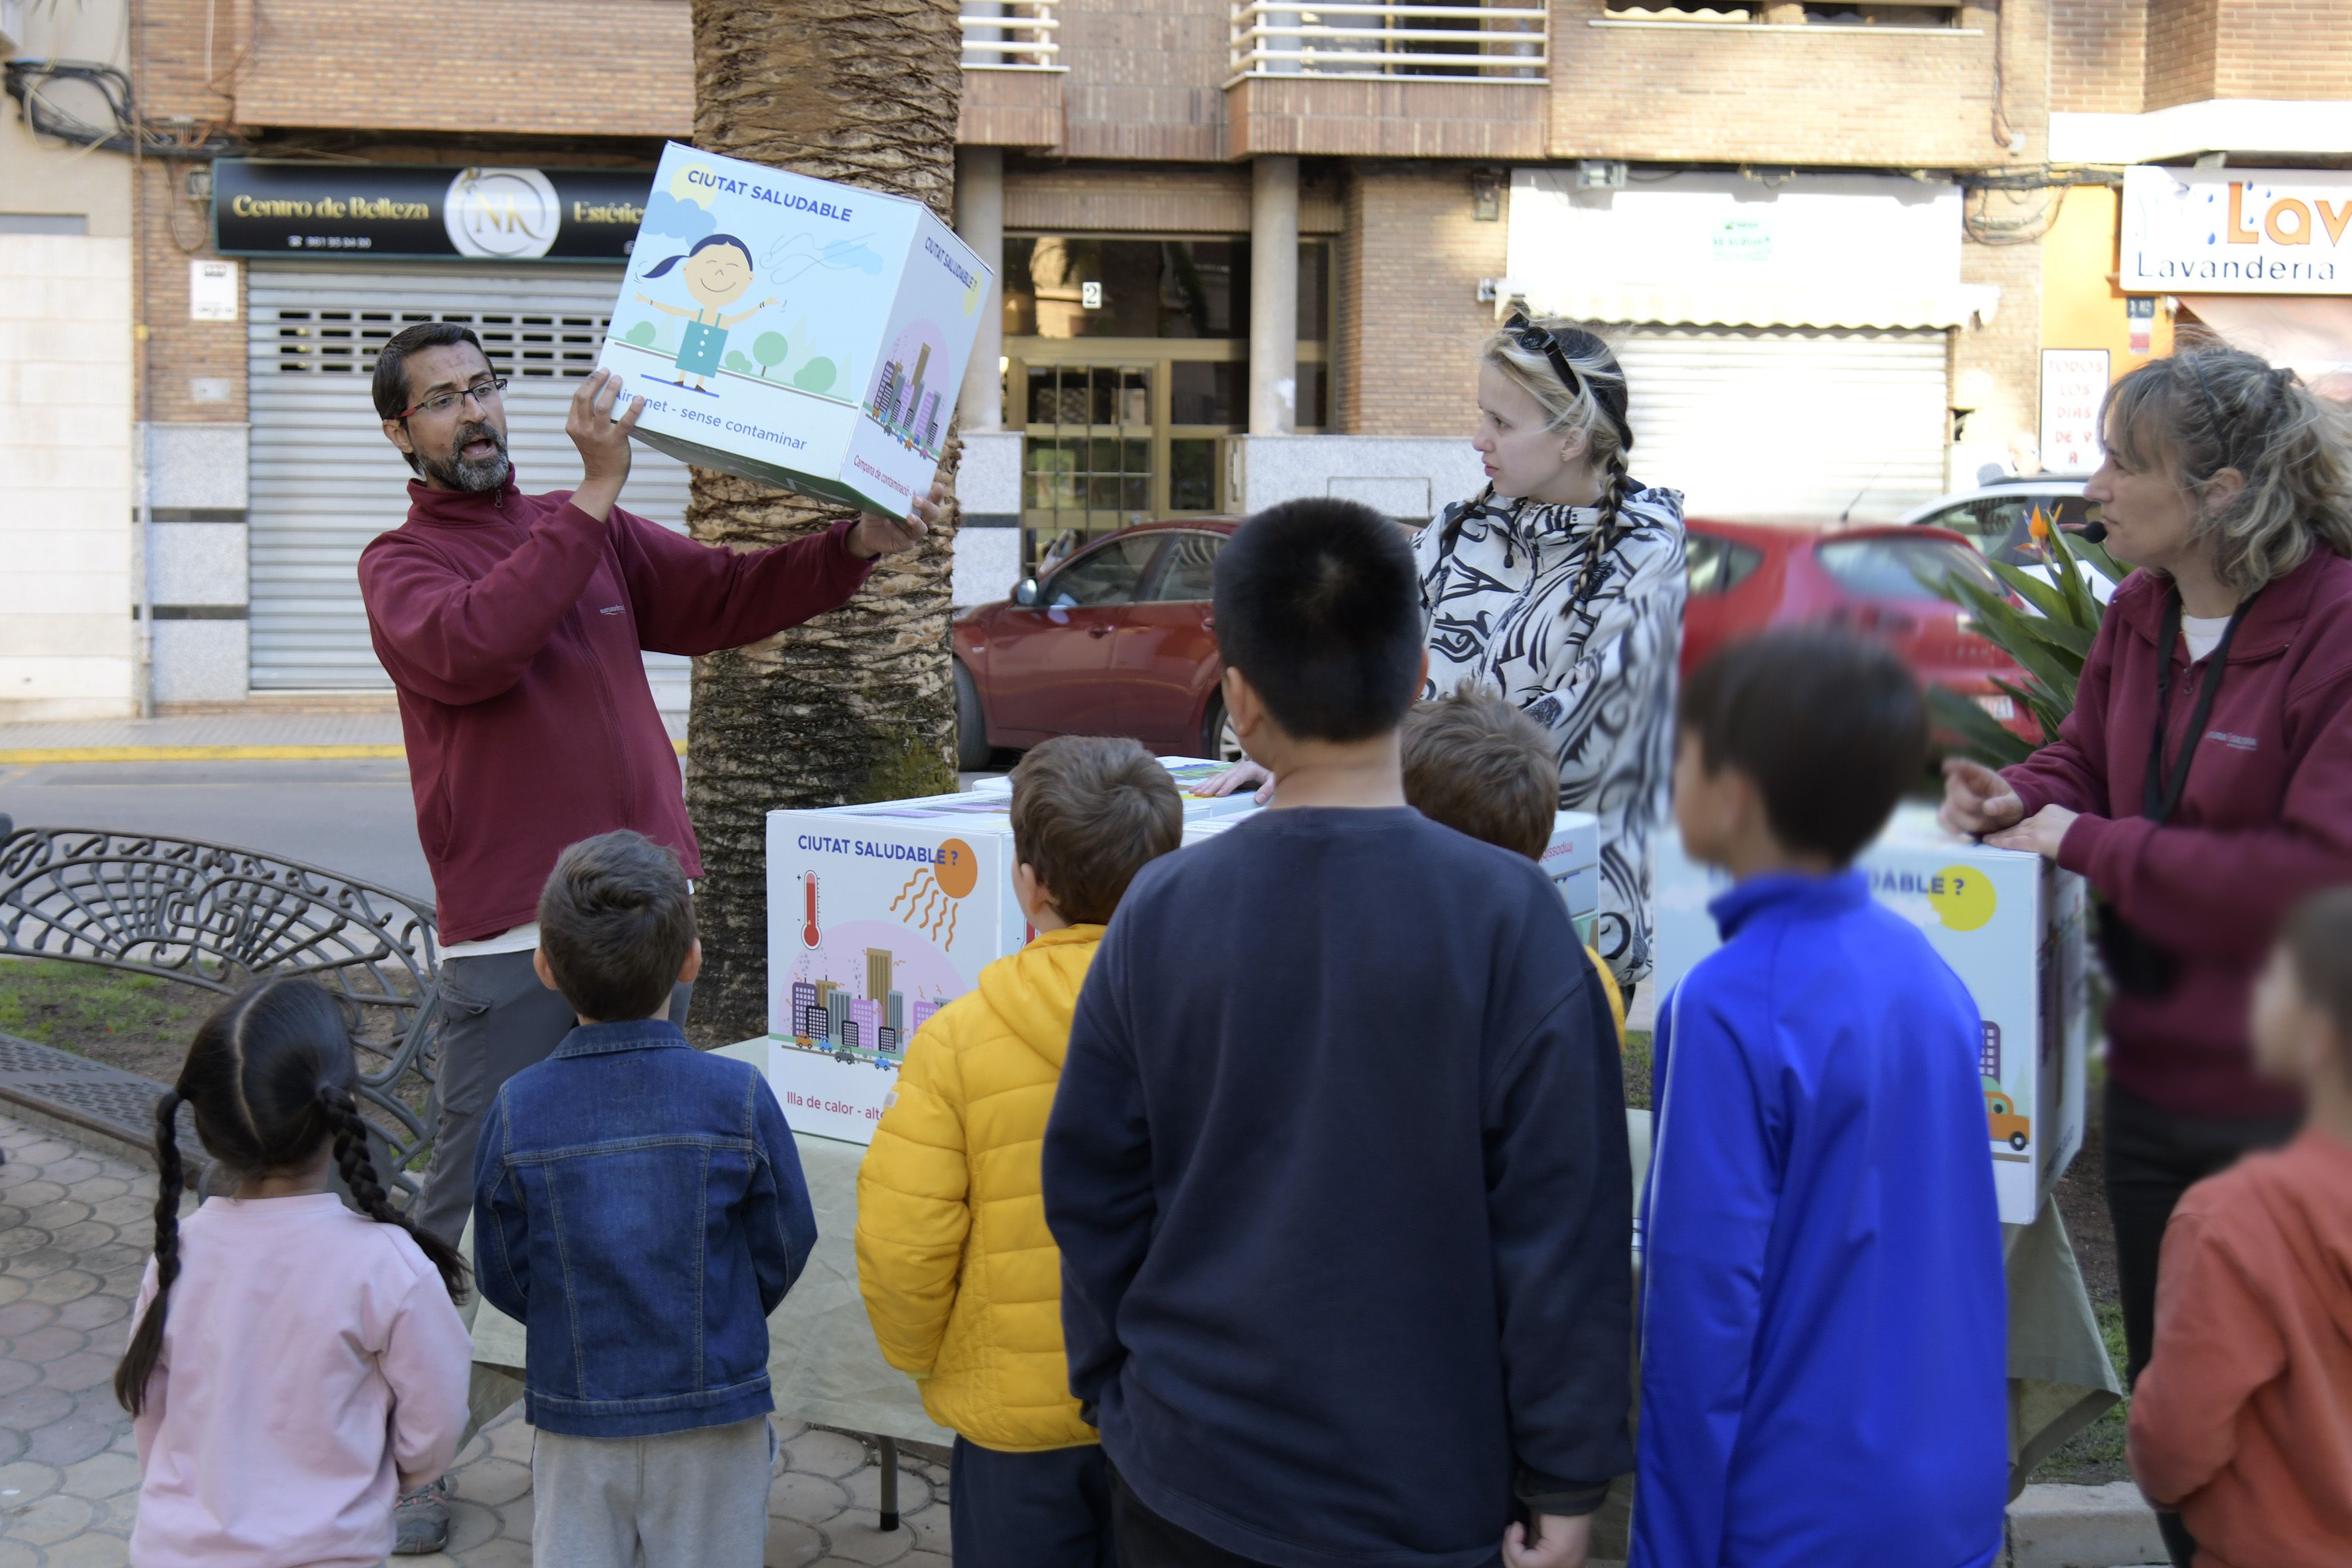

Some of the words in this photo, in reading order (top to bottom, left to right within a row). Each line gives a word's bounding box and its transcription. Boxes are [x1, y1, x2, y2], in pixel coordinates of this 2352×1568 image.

[232, 195, 313, 218] Centro
[315, 196, 347, 219] de
[349, 196, 430, 220] Belleza
[688, 170, 747, 195] CIUTAT
[751, 186, 852, 222] SALUDABLE
[2227, 182, 2352, 248] Lav
[1085, 285, 1097, 304] 2
[2060, 383, 2090, 396] LOS
[643, 396, 668, 413] net
[680, 407, 722, 428] sense
[726, 420, 808, 450] contaminar
[854, 455, 874, 476] Campana
[874, 469, 881, 481] de
[798, 834, 850, 854] CIUTAT
[854, 840, 946, 865] SALUDABLE
[951, 850, 959, 866] ?
[1954, 878, 1964, 896] ?
[787, 1091, 803, 1107] Illa
[807, 1095, 821, 1109] de
[824, 1100, 854, 1115] calor
